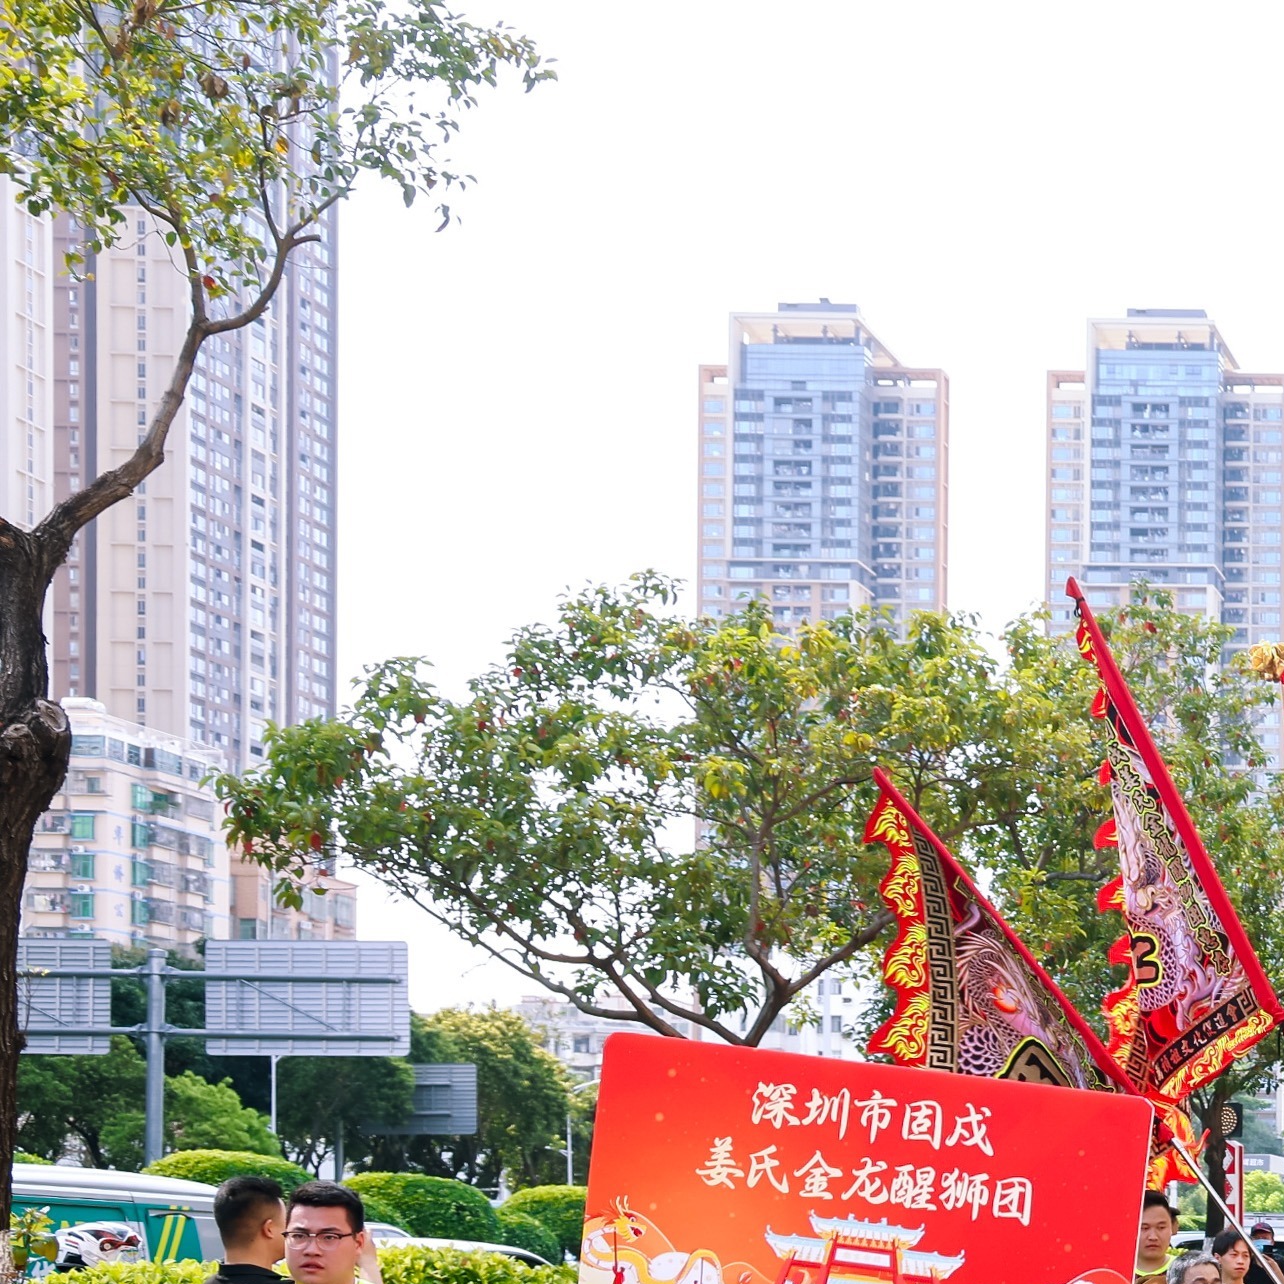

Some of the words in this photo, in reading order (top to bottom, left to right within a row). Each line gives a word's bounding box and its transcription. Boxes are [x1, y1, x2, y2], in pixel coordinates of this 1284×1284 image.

[751, 1080, 993, 1157] 深圳市固戍
[695, 1136, 1033, 1226] 姜氏金龙醒狮团
